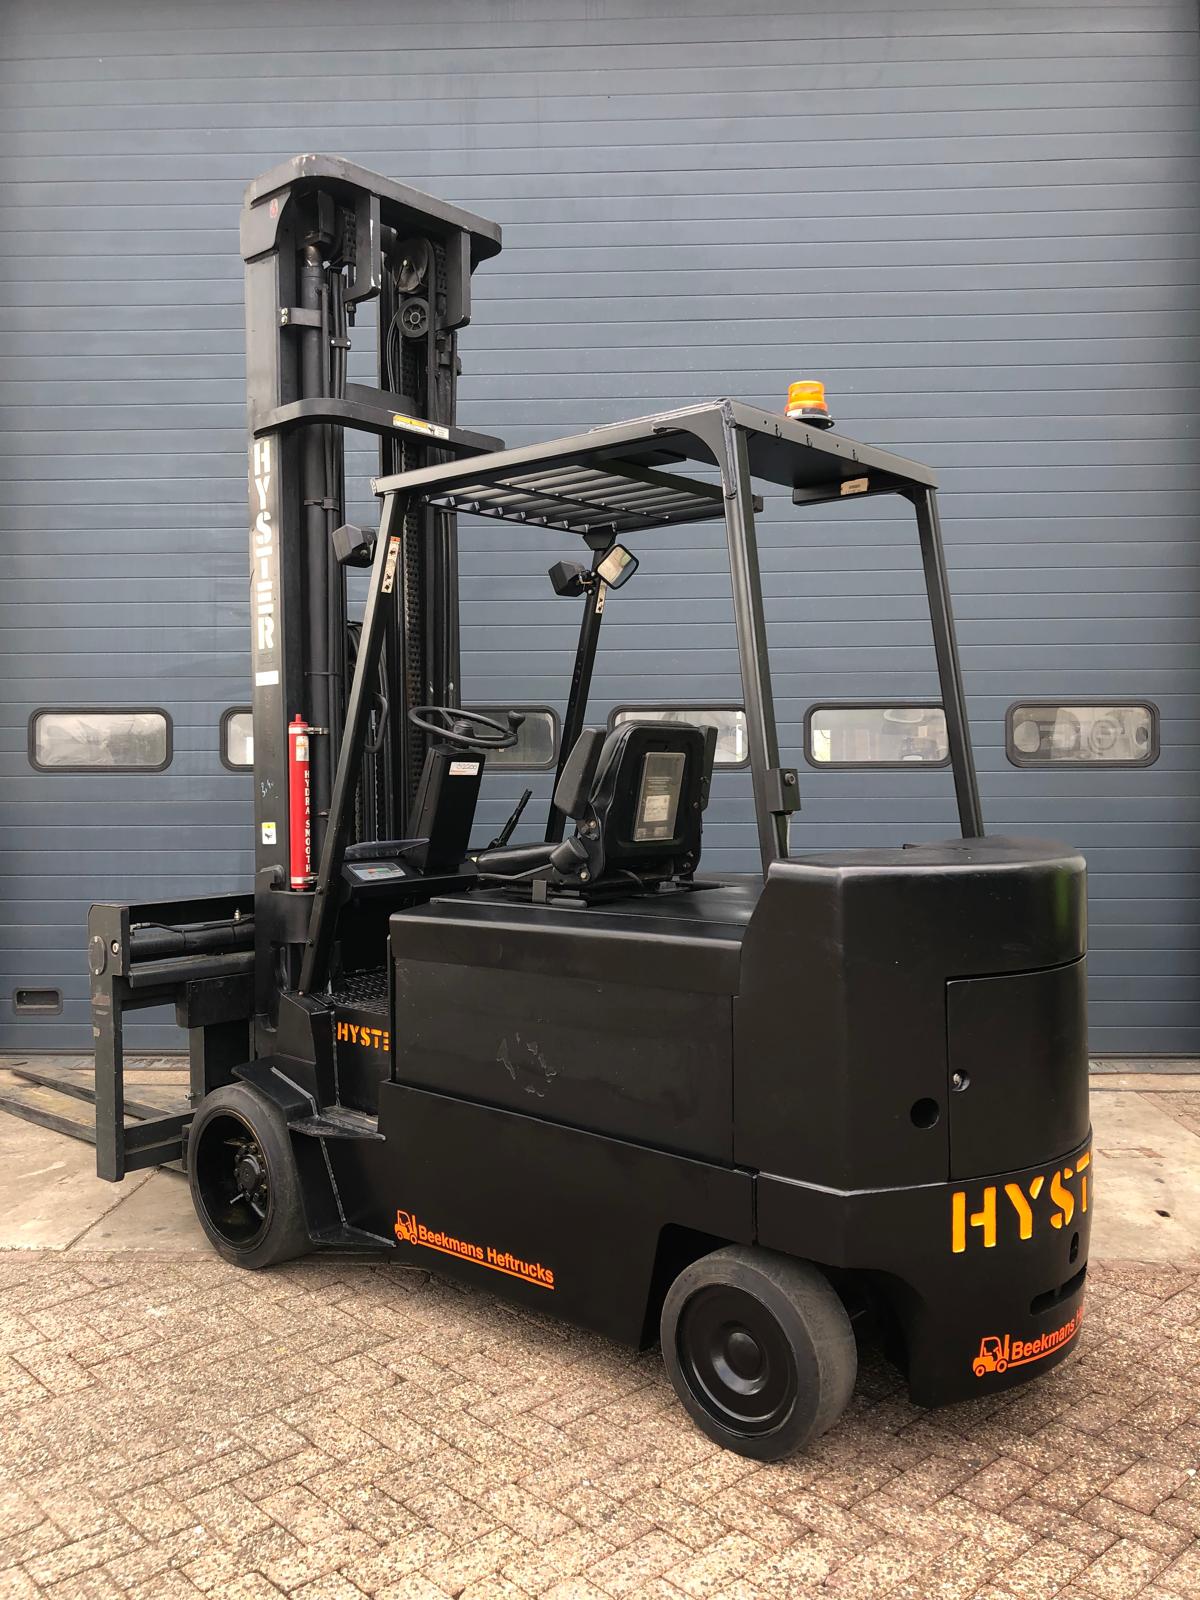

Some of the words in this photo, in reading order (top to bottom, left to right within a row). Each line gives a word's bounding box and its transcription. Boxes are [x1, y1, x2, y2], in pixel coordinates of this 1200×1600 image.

[253, 440, 275, 650] HYSTER
[418, 1224, 484, 1260] Beekmans
[487, 1246, 554, 1284] Heftrucks
[1011, 1318, 1075, 1360] Beekmans
